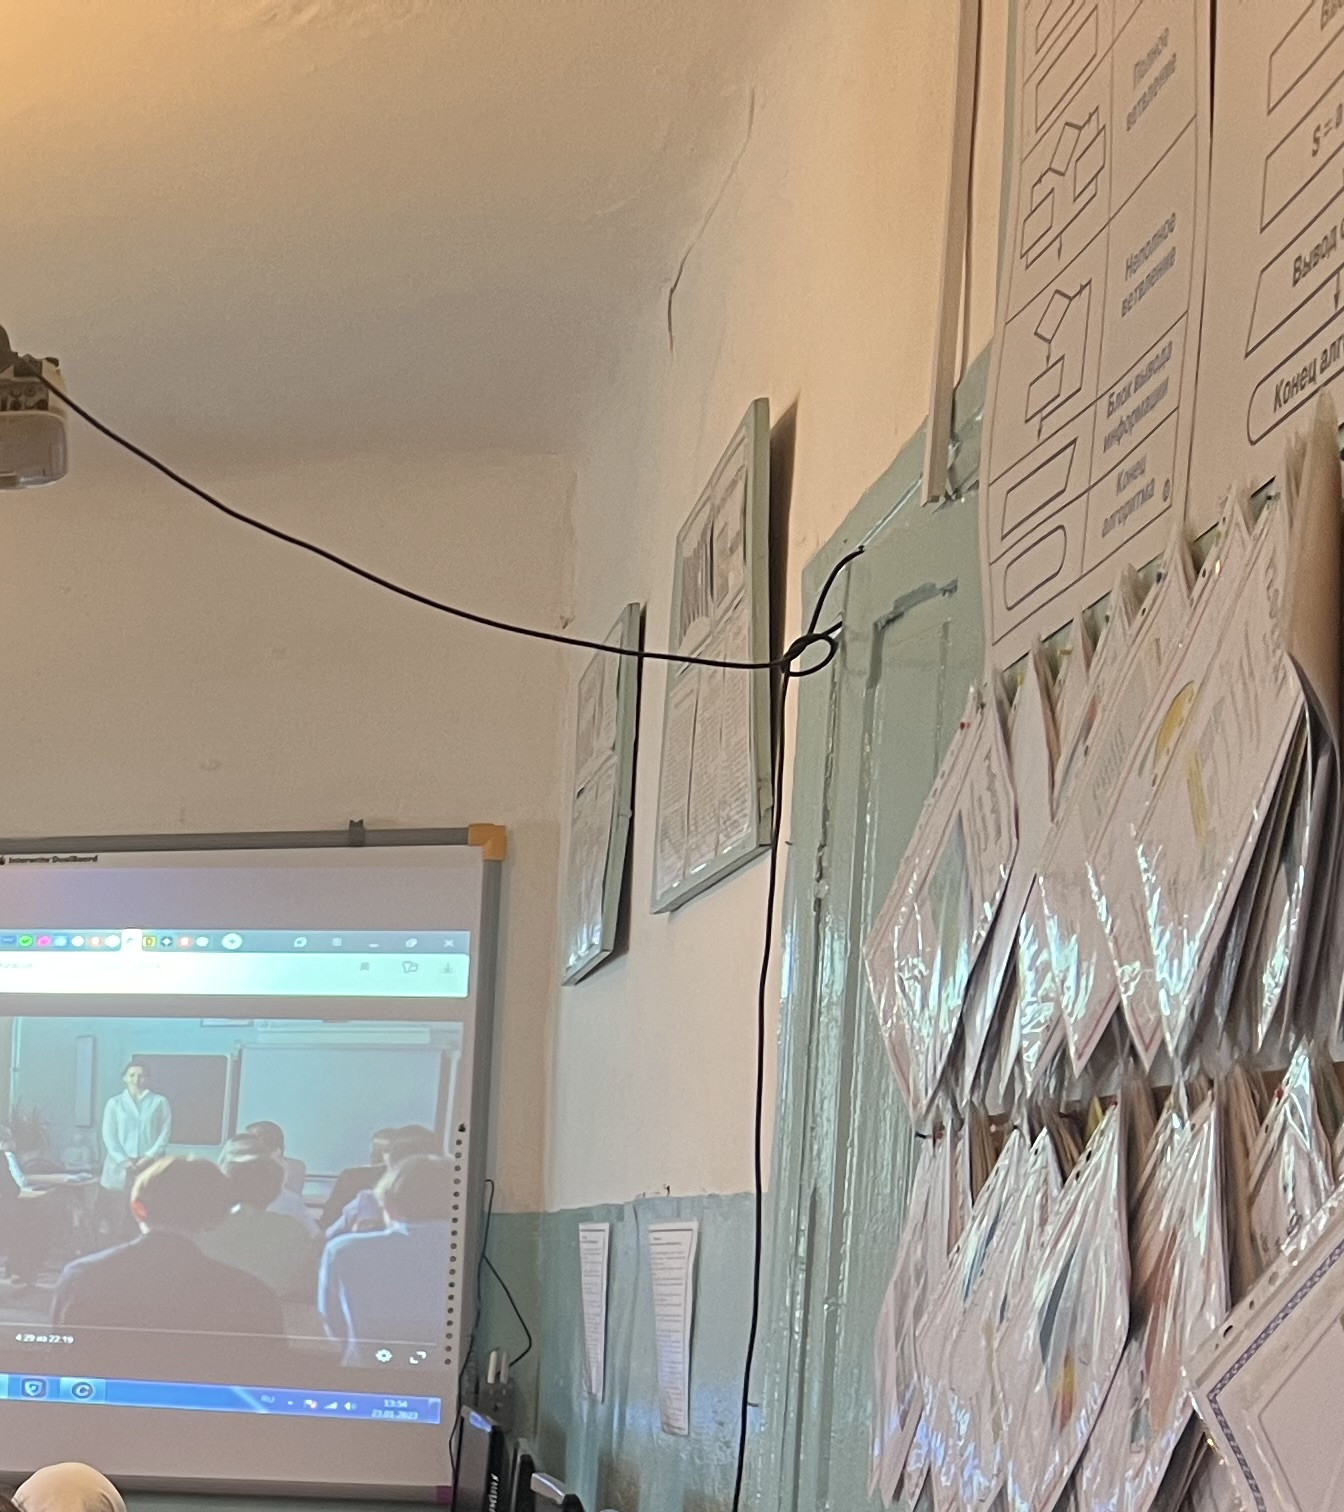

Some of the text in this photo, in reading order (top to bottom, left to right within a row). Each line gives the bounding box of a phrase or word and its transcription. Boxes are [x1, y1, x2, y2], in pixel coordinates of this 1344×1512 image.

[1312, 123, 1321, 157] S
[1323, 118, 1334, 138] =
[1125, 211, 1176, 281] Неполное
[1292, 225, 1338, 287] Вывод
[1107, 340, 1173, 418] Блок вывода
[1274, 357, 1318, 413] Конец
[1103, 375, 1169, 453] информации
[1116, 452, 1147, 496] Конец
[1102, 477, 1155, 538] алгоритма
